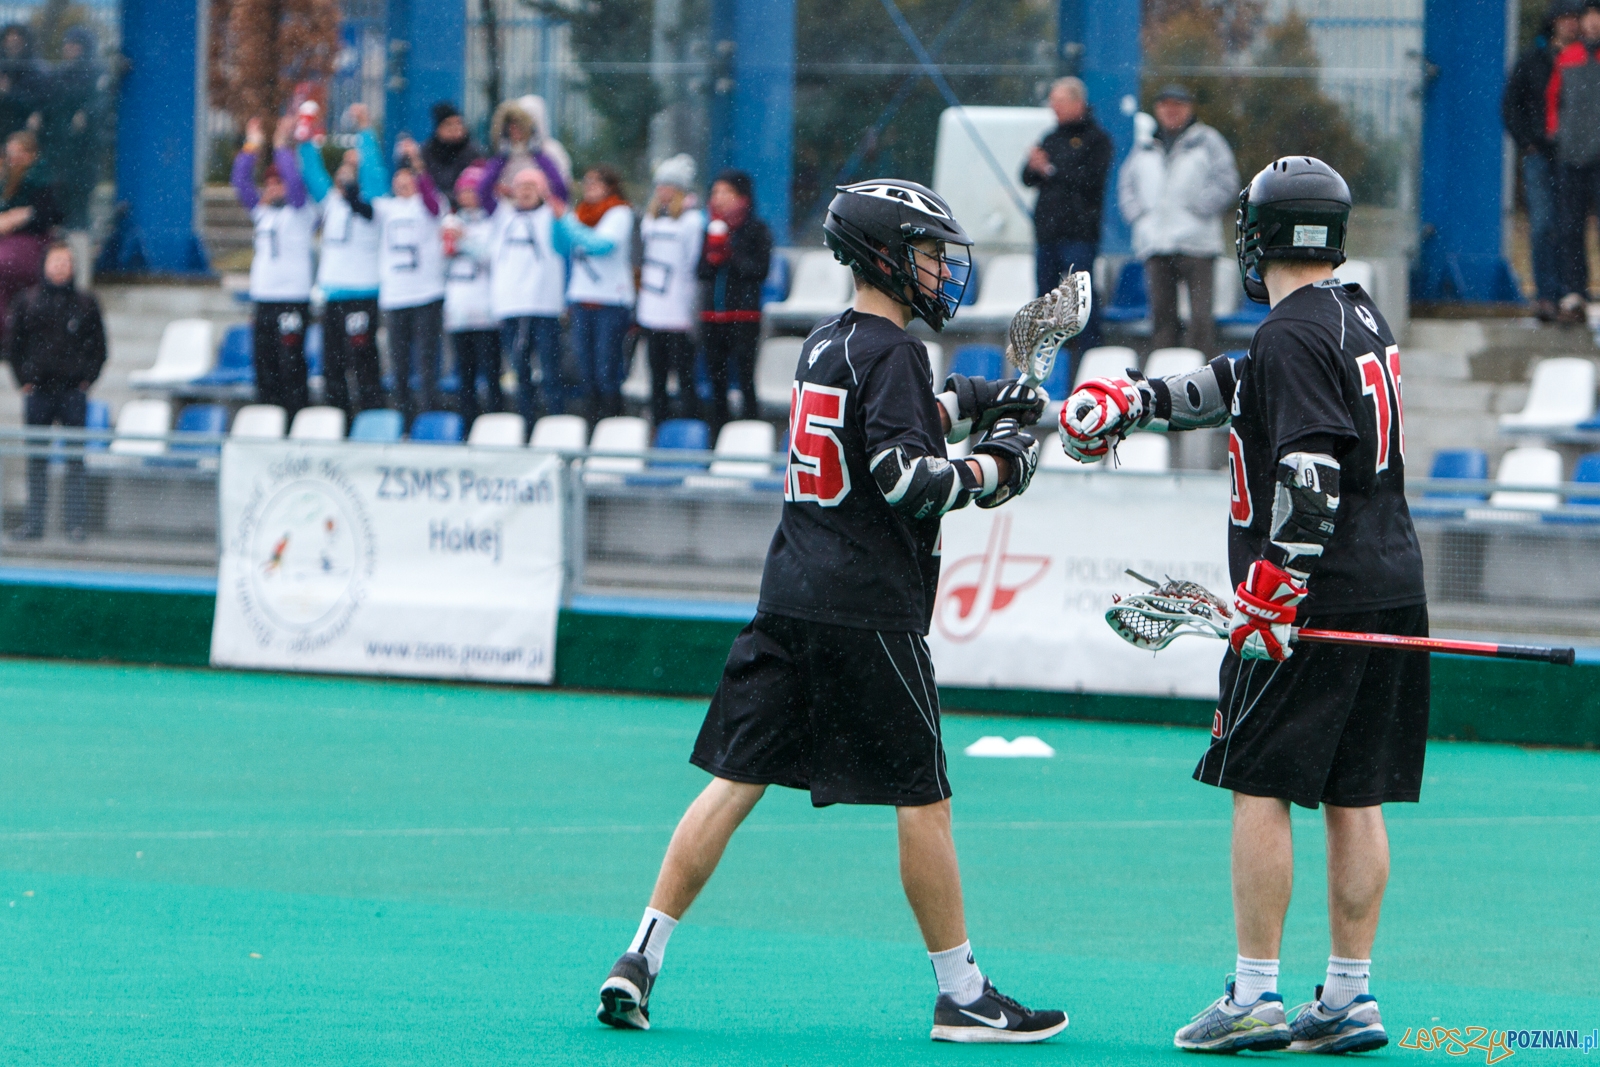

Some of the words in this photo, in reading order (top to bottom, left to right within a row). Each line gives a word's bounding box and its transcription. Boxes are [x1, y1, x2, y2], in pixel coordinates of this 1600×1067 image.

[1355, 344, 1405, 475] 1
[784, 380, 851, 507] 5
[376, 466, 451, 498] ZSMS
[914, 498, 935, 519] STX
[429, 518, 502, 563] Hokej
